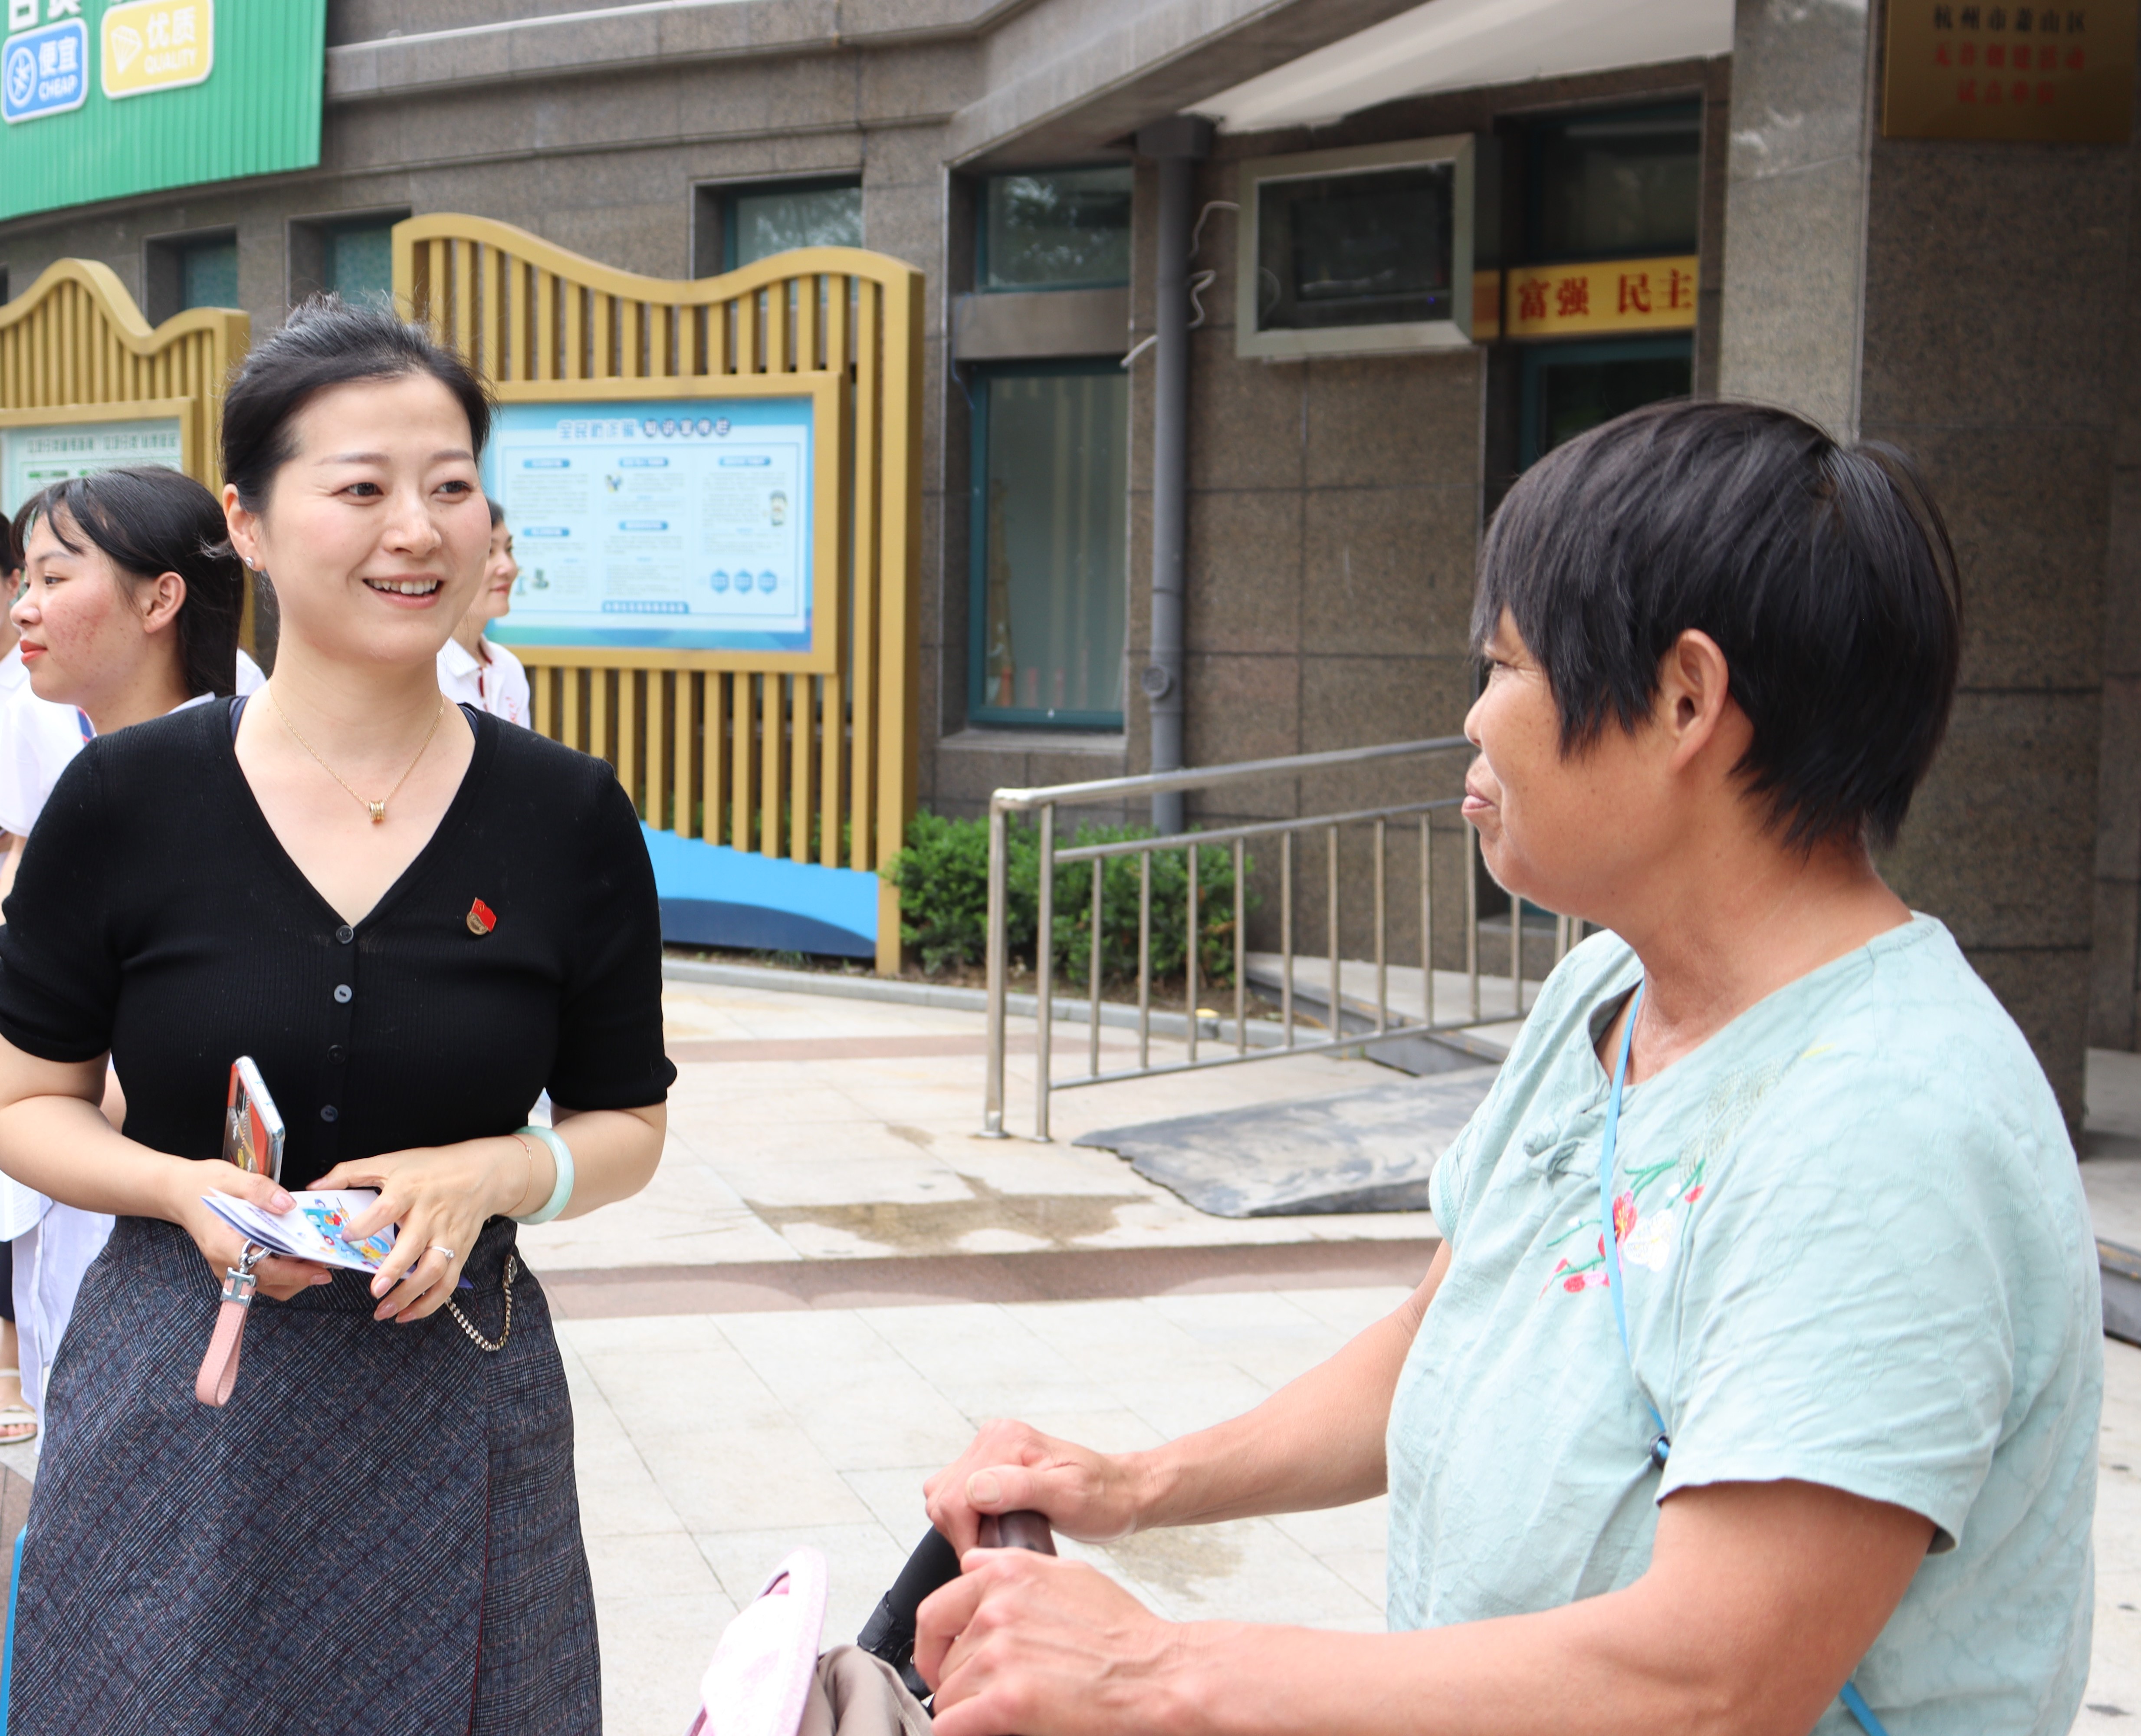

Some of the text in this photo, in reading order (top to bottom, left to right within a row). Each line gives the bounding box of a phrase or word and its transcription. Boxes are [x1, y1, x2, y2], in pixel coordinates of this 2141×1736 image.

[146, 7, 196, 48] 优质
[39, 37, 78, 75] 便宜
[144, 49, 197, 74] QUALITY
[39, 75, 77, 100] CHEAP
[1519, 269, 1693, 320] 富强 民主
